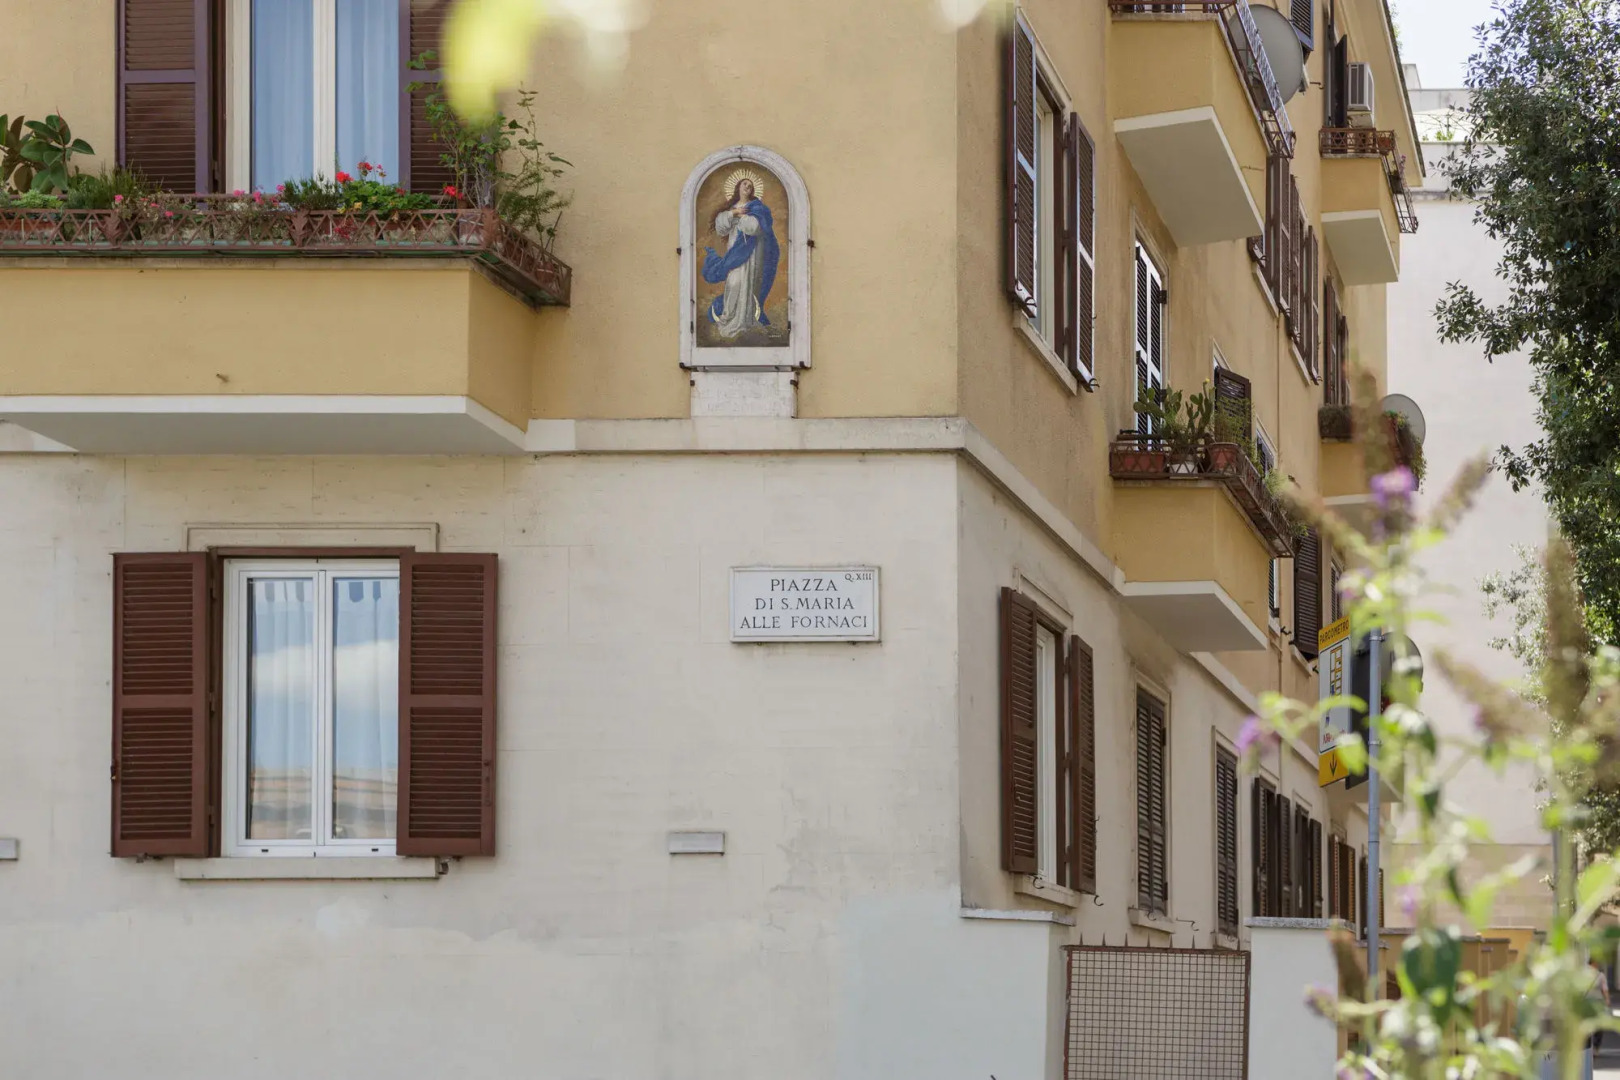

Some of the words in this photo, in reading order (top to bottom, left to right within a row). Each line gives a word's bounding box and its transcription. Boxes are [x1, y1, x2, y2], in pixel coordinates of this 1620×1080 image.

[770, 578, 838, 591] PIAZZA
[755, 597, 773, 610] DI
[740, 616, 781, 629] ALLE
[791, 615, 867, 628] FORNACI
